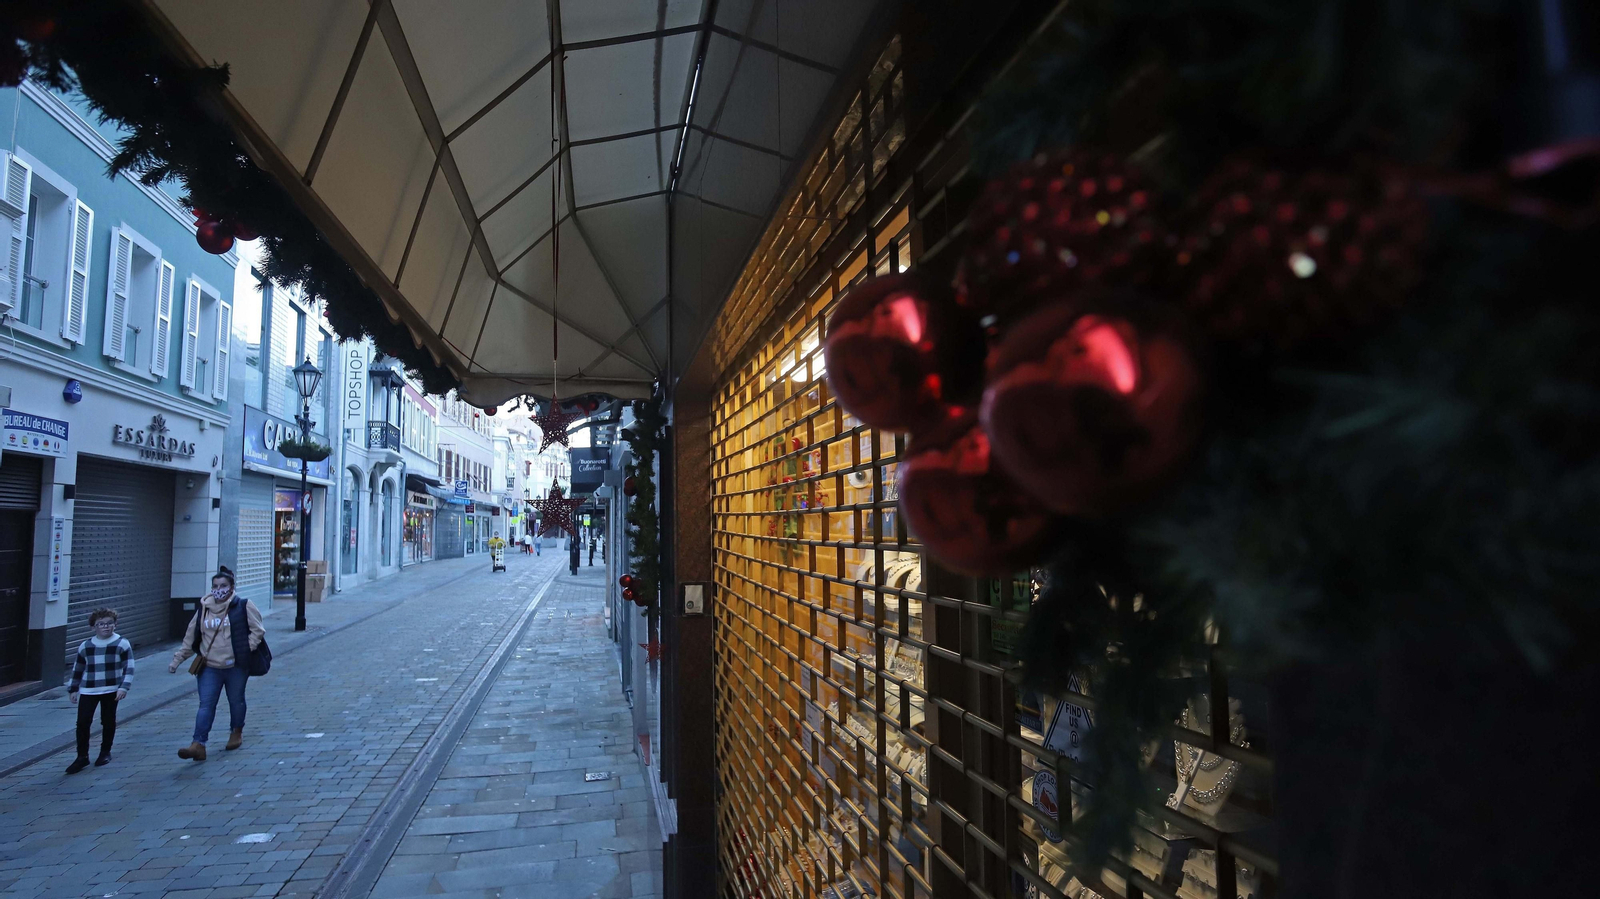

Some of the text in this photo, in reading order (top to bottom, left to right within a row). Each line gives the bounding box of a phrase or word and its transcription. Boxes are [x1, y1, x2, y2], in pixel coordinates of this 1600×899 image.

[347, 349, 363, 420] TOPSHOP
[4, 414, 32, 428] BUREAU
[32, 418, 41, 430] de
[41, 419, 66, 438] CHANGE
[112, 424, 196, 456] ESSARDAS
[139, 449, 173, 463] LUXURY
[204, 616, 231, 629] TIRE
[1065, 703, 1082, 718] FIND
[1069, 717, 1079, 729] US
